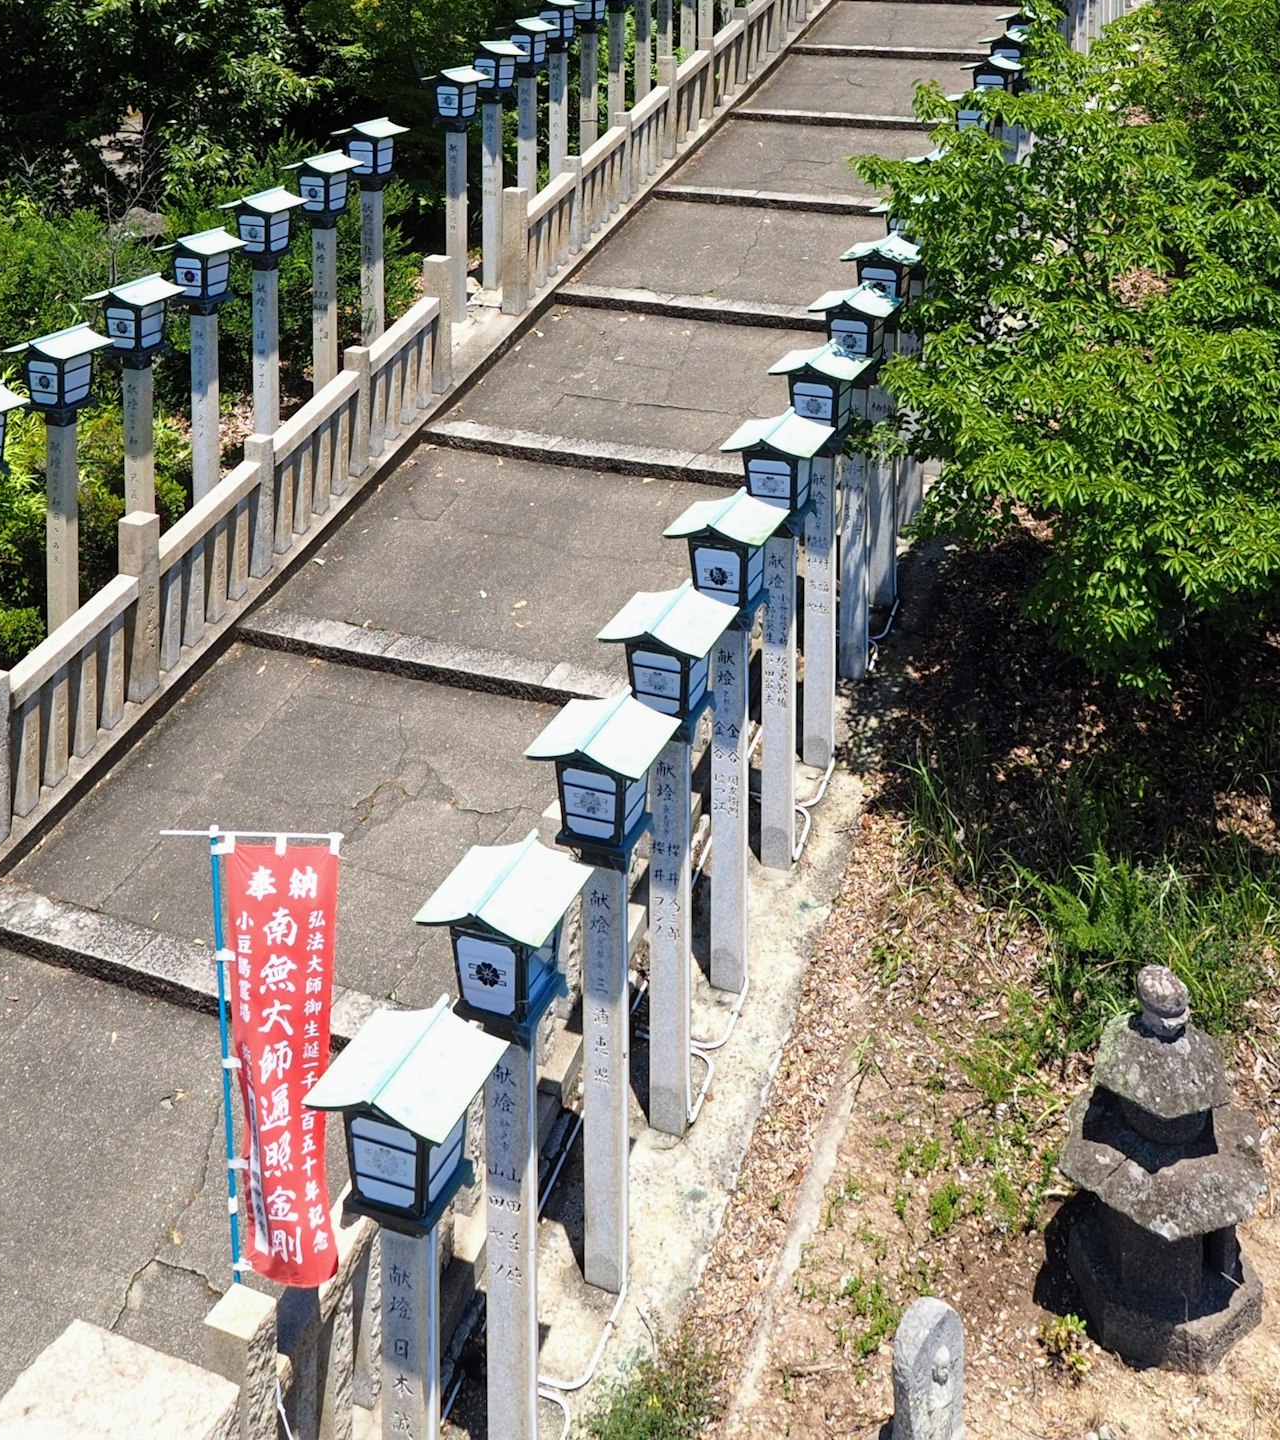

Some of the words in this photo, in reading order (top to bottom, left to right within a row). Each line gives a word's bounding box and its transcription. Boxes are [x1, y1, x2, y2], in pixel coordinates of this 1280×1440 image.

[768, 553, 786, 589] 献燈
[717, 648, 736, 688] 献燈
[656, 759, 677, 802] 献燈
[246, 864, 319, 902] 奉納
[589, 889, 611, 935] 献燈
[299, 909, 329, 1255] 弘法大師御生誕一千百五十年記念
[491, 1062, 517, 1115] 献燈
[386, 1262, 415, 1321] 献燈
